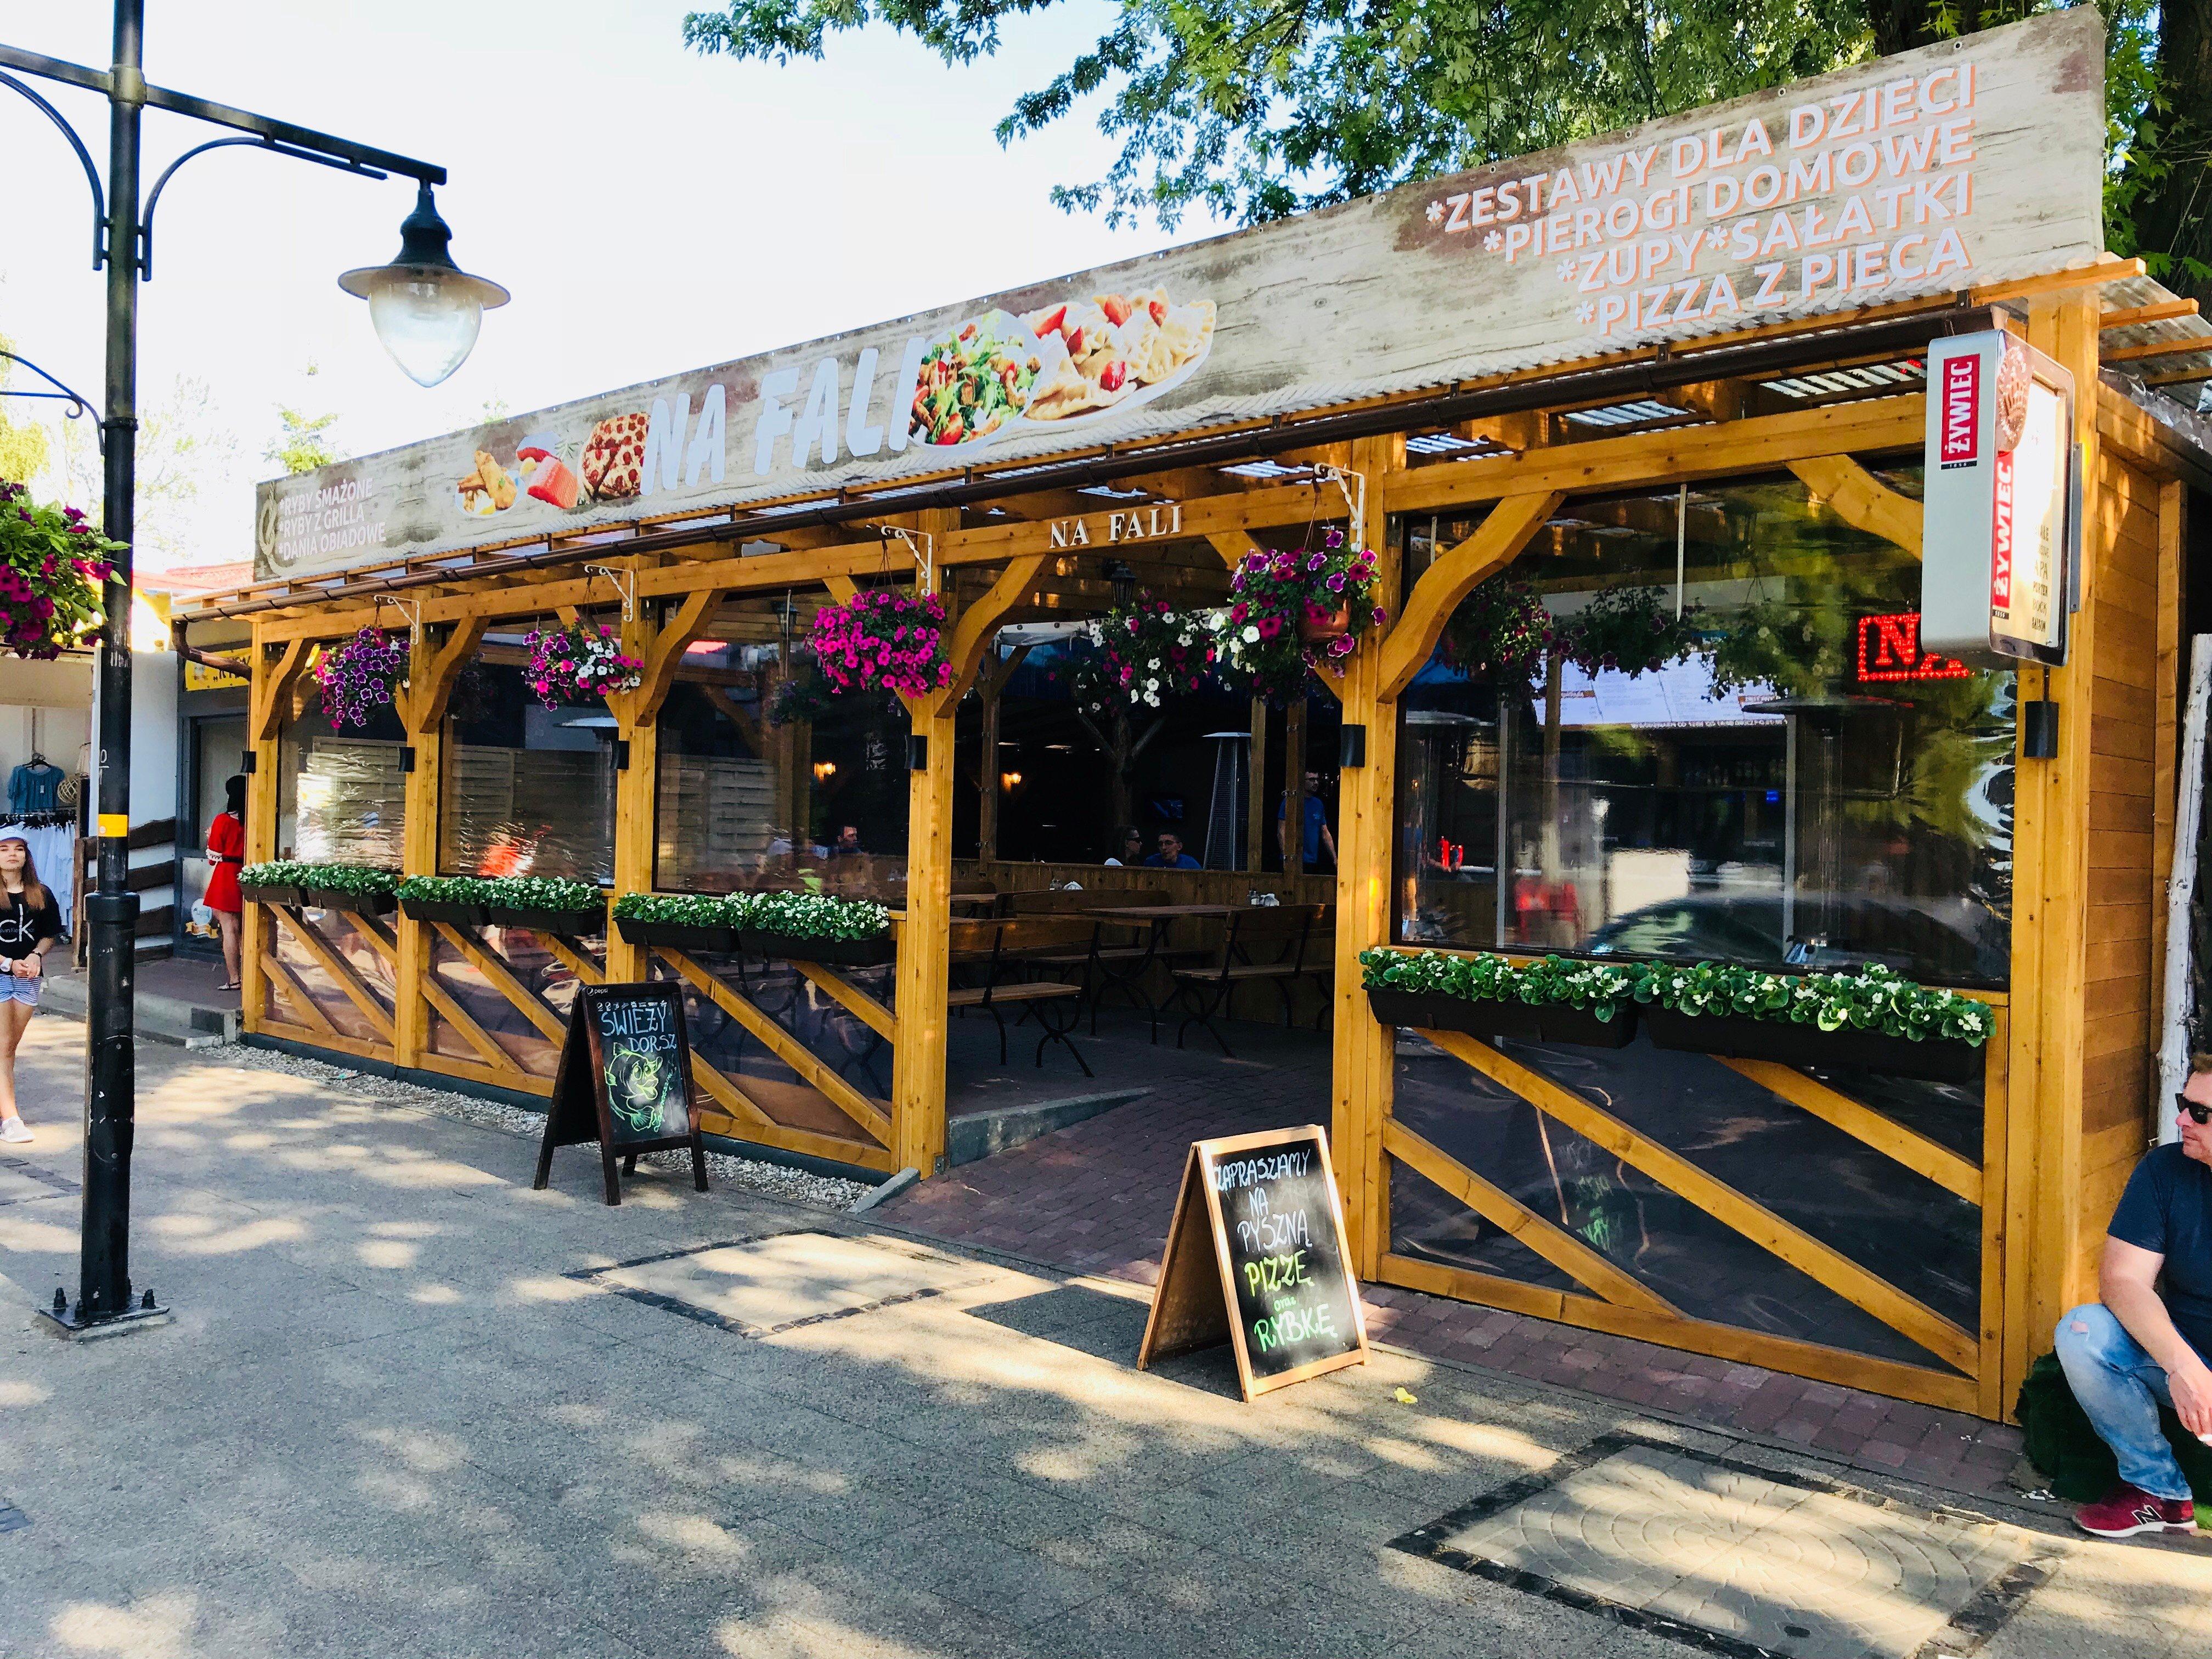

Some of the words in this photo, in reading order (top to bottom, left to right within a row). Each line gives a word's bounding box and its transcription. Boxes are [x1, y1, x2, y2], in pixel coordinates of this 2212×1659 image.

[1671, 117, 1773, 180] DLA
[1789, 63, 1975, 150] DZIECI
[1705, 117, 1974, 218] DOMOWE
[1754, 264, 1787, 306] Z
[1801, 228, 1972, 301] PIECA
[640, 385, 726, 495] NA
[754, 337, 926, 475] FALI
[1944, 361, 1973, 454] ŻYWIEC
[315, 477, 374, 509] SMAŻONE
[314, 512, 321, 531] Z
[324, 503, 364, 530] GRILLA
[320, 522, 386, 553] OBIADOWE
[1049, 517, 1090, 549] NA
[1108, 505, 1182, 542] FALI
[1994, 461, 2011, 597] ŻYWIEC
[628, 1034, 676, 1053] DORSZ
[1214, 1149, 1311, 1192] ZAPRASZAMY
[1249, 1187, 1268, 1217] NA
[1237, 1208, 1313, 1252] PYSZNĄ
